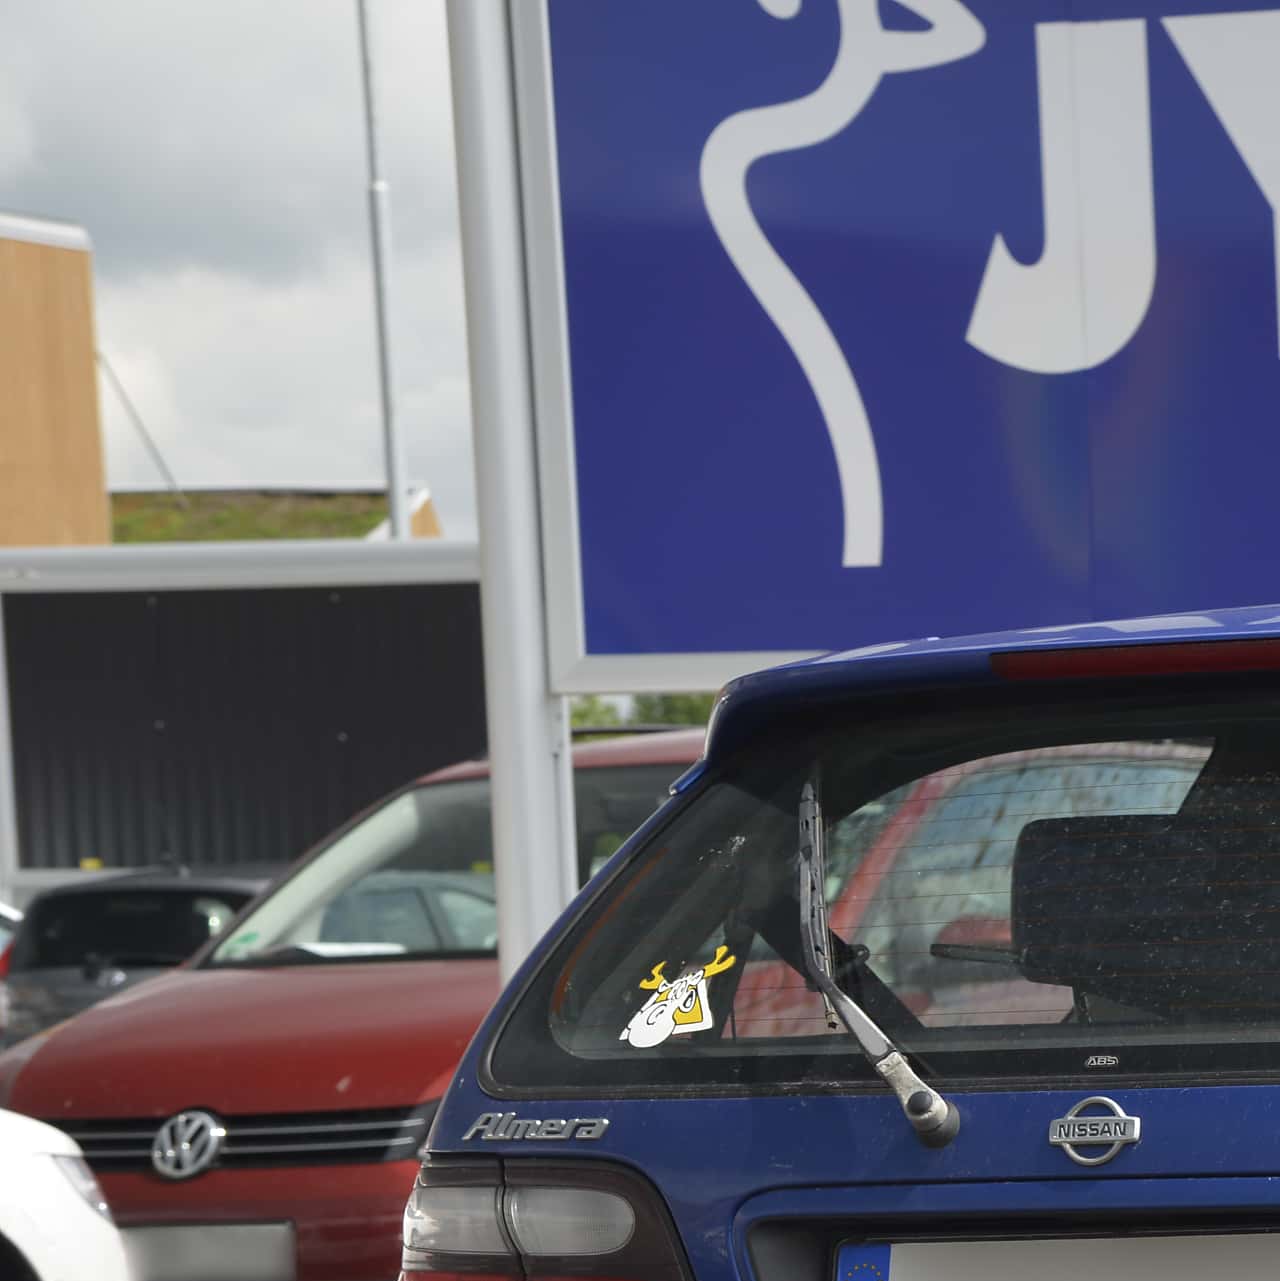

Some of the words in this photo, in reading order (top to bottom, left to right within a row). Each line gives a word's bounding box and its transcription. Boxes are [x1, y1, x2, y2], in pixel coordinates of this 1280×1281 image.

[1086, 1055, 1119, 1067] ABS
[461, 1112, 610, 1141] Almera
[1057, 1121, 1128, 1139] NISSAN
